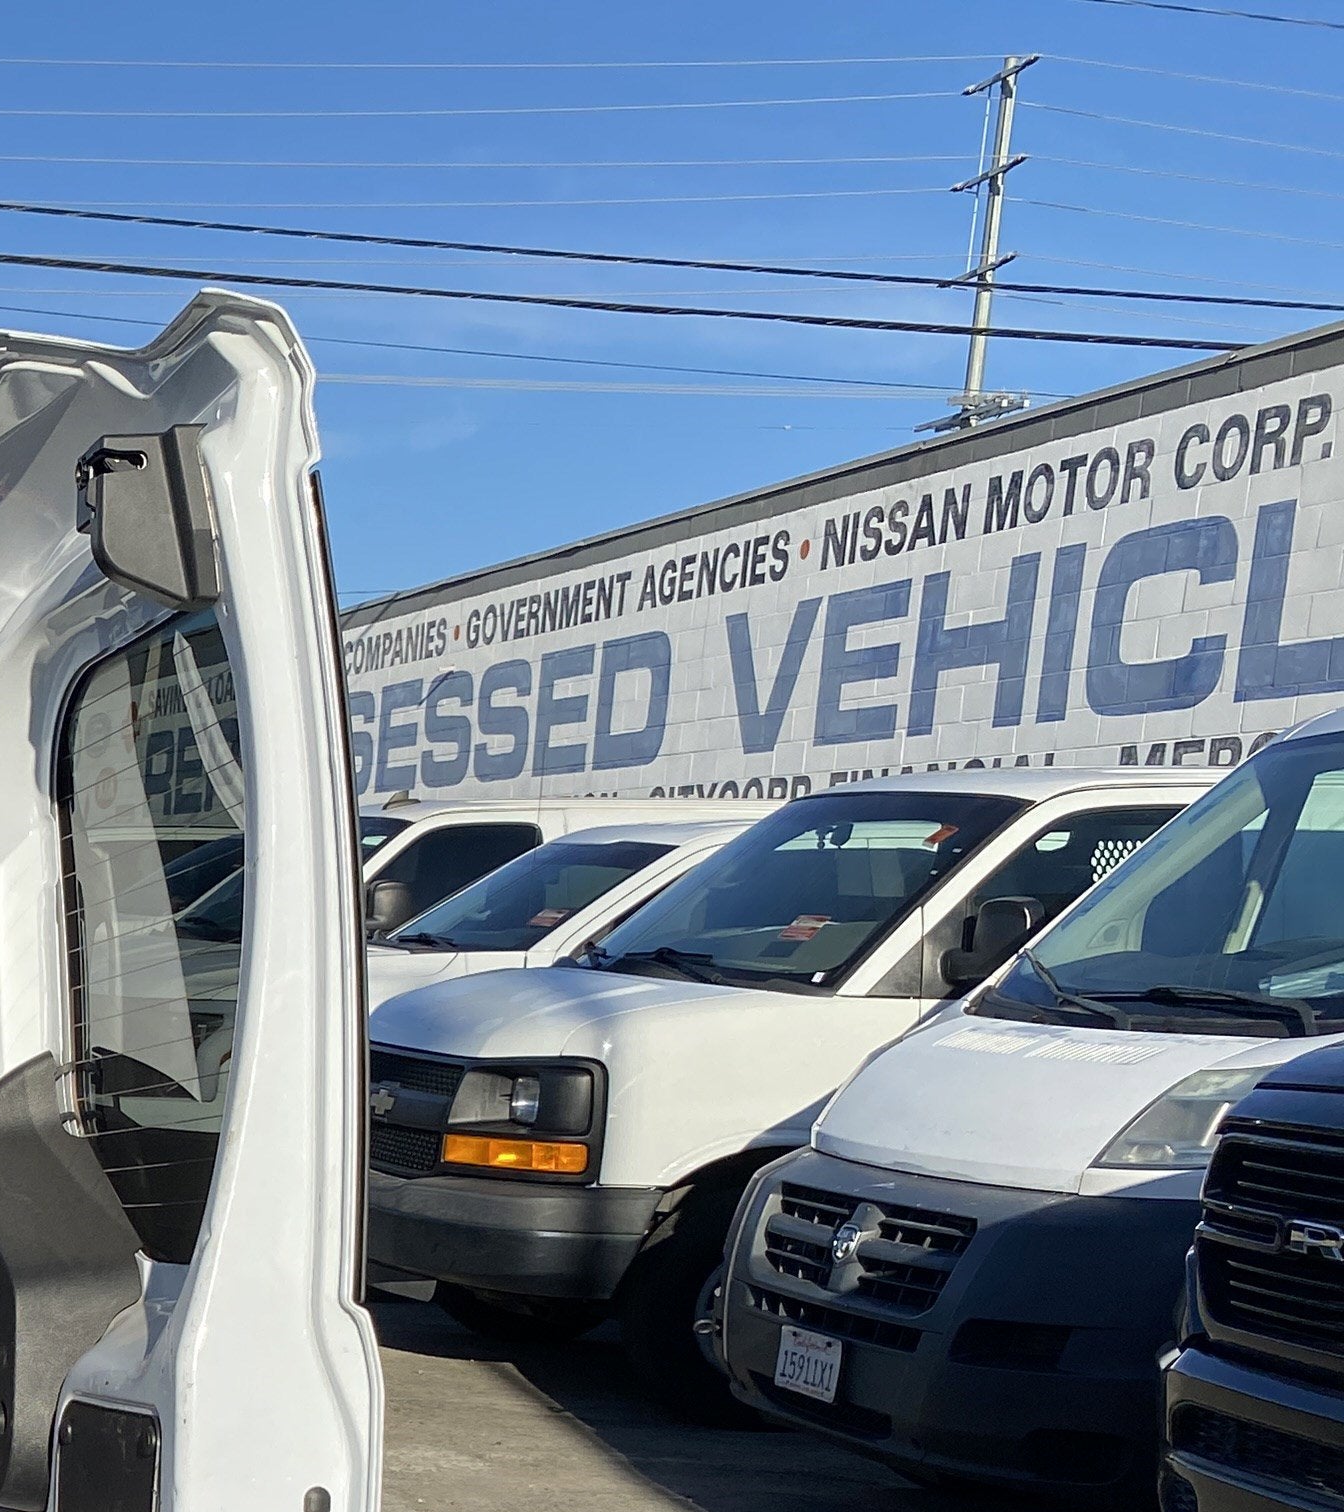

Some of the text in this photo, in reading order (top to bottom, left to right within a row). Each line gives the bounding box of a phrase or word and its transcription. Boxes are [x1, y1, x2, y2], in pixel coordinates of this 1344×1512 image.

[345, 617, 447, 675] COMPANIES
[466, 571, 632, 649] GOVERNMENT
[637, 529, 790, 612] AGENCIES
[820, 482, 972, 571] NISSAN
[983, 438, 1155, 534] MOTOR
[1175, 393, 1333, 490] CORP.
[726, 499, 1344, 754] VEHICL
[780, 1350, 834, 1392] 15911X1
